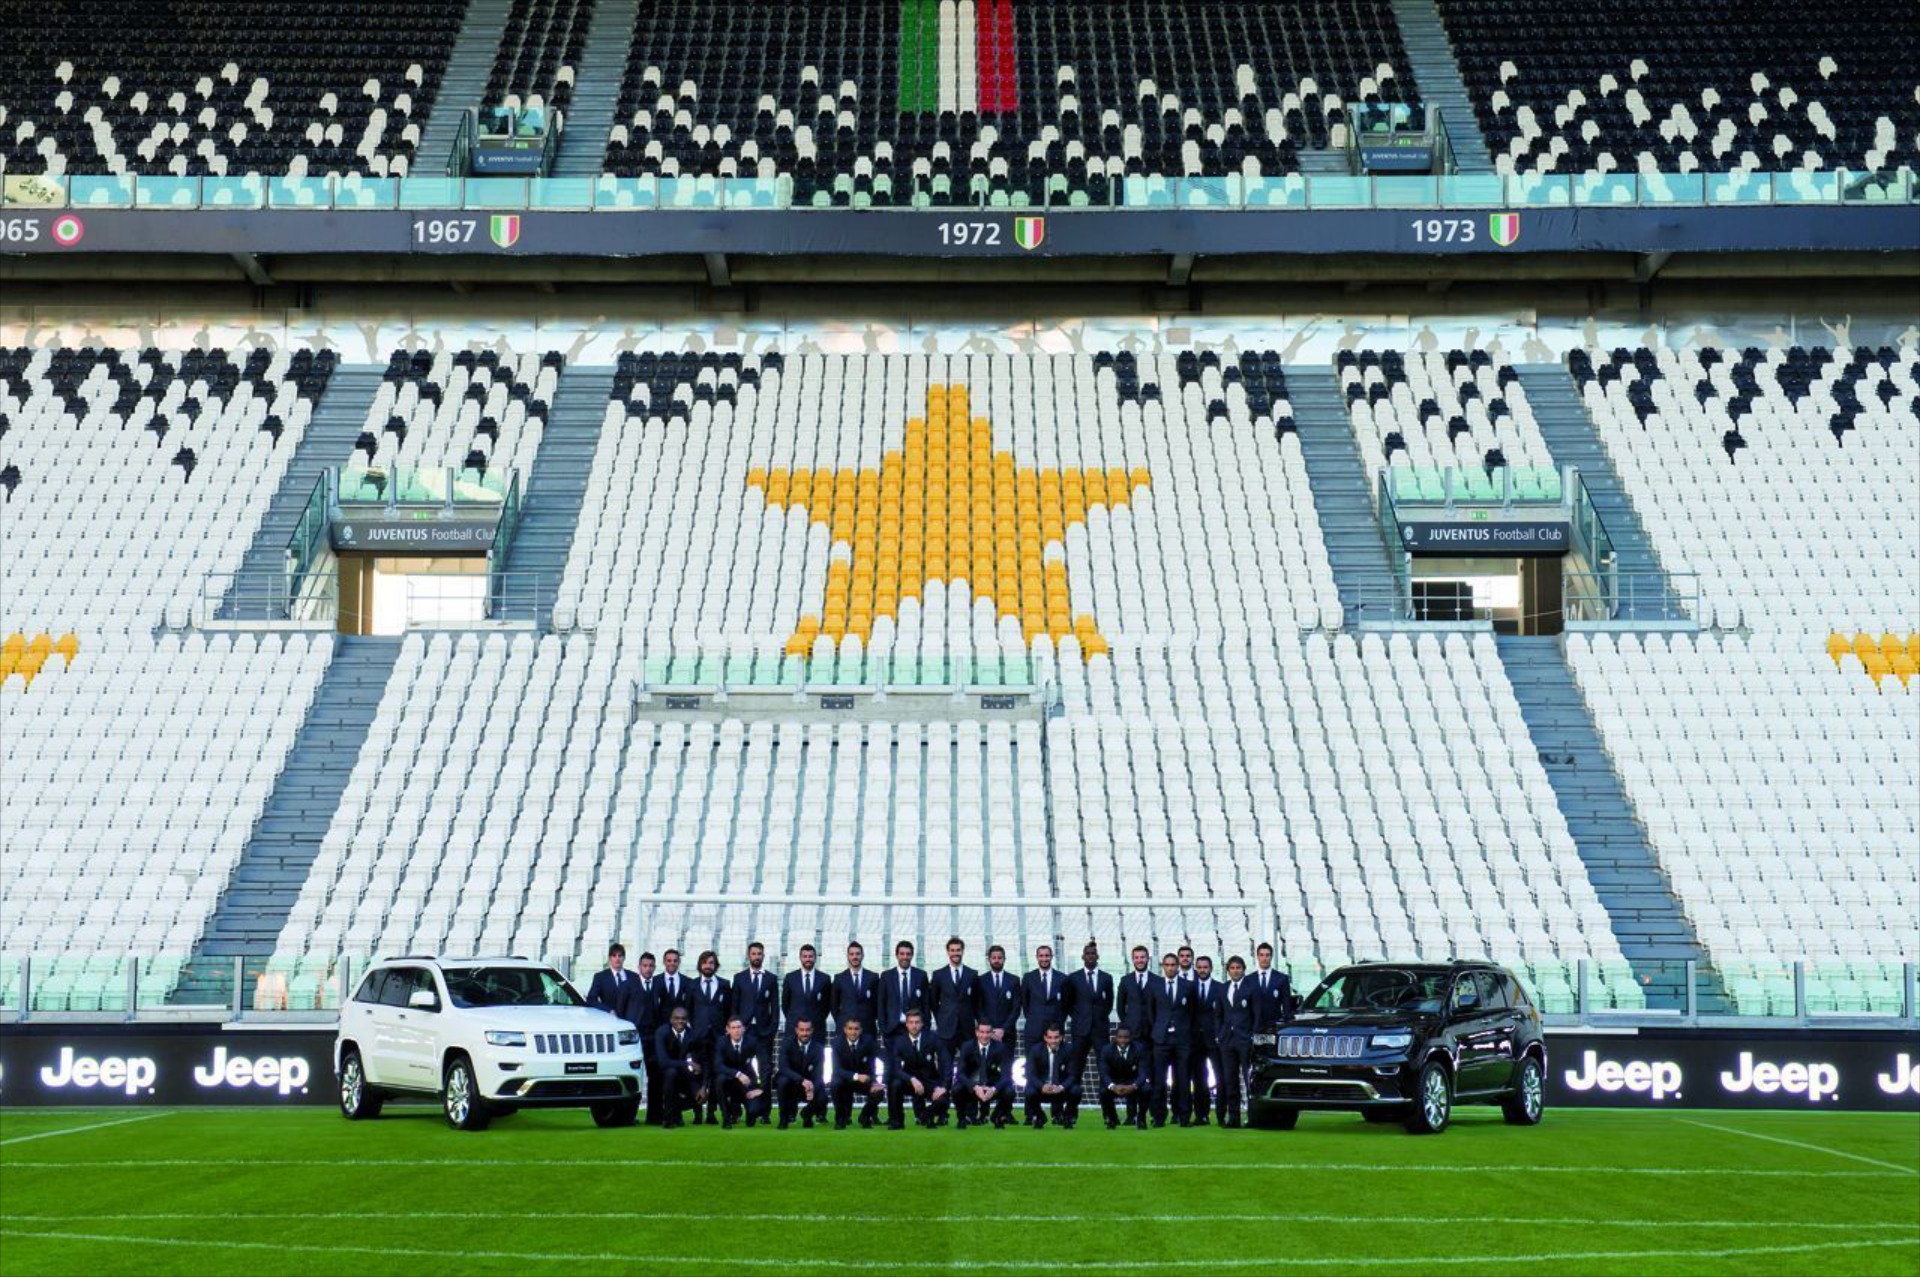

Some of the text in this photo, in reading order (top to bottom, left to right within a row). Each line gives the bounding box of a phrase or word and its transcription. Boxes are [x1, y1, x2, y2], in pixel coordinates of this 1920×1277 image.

[413, 220, 476, 243] 1967
[938, 222, 1001, 245] 1972
[1411, 219, 1475, 242] 1973
[367, 528, 428, 541] JUVENTUS
[431, 528, 472, 541] Football
[1429, 528, 1562, 541] JUVENTUS Football Club
